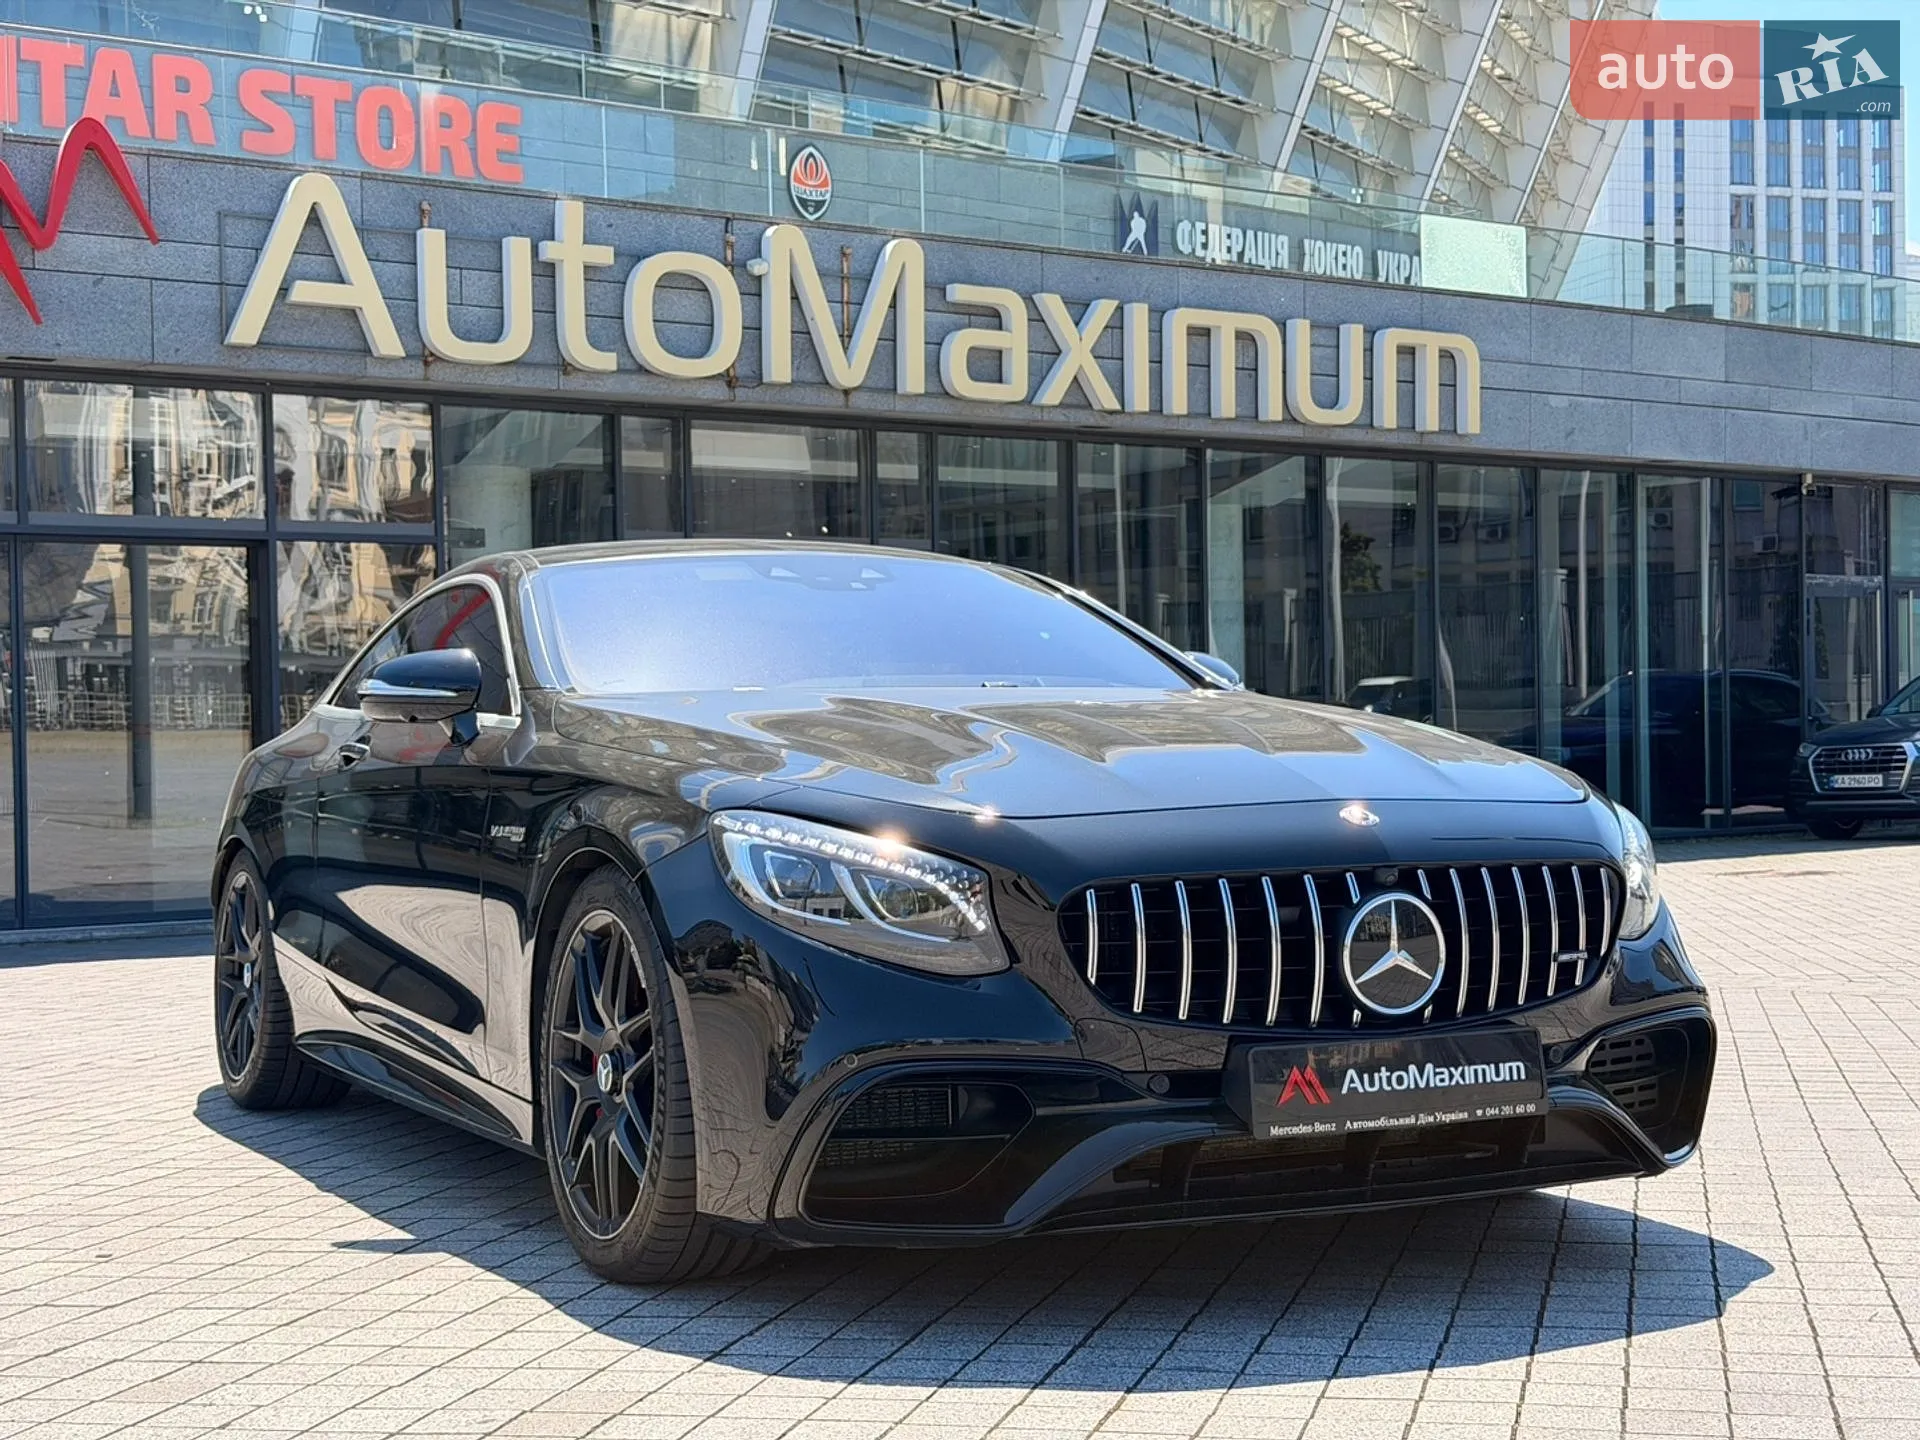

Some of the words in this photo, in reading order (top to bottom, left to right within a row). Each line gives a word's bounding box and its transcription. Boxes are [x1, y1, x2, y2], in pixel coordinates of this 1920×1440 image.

[239, 69, 523, 183] STORE
[1176, 220, 1289, 270] ФЕДЕРАЦІЯ
[1303, 239, 1363, 280] ХОКЕЮ
[224, 172, 1482, 436] AutoMaximum
[1341, 1061, 1526, 1094] AutoMaximum
[1485, 1107, 1499, 1117] 044
[1501, 1104, 1514, 1115] 201
[1526, 1102, 1536, 1113] 00
